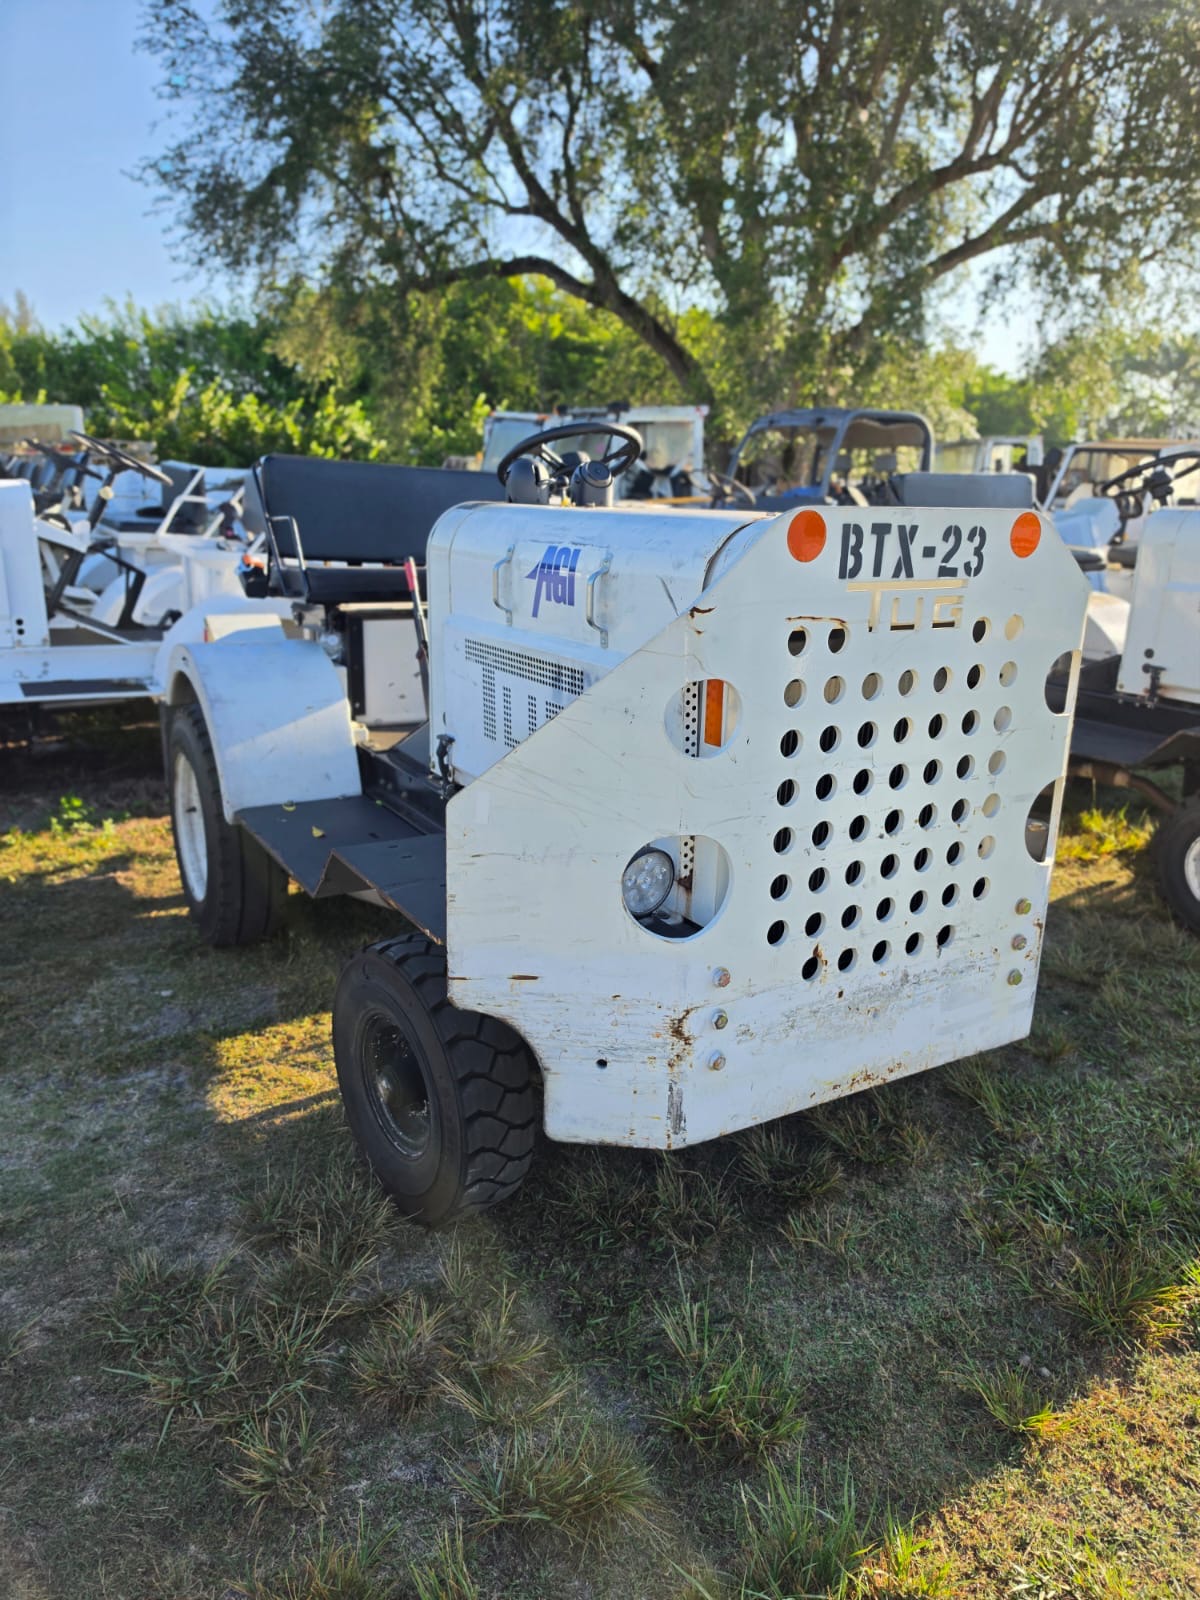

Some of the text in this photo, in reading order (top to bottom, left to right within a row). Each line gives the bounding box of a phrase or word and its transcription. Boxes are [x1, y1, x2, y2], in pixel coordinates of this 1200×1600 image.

[525, 545, 581, 618] AGI
[838, 523, 987, 579] BTX-23
[847, 579, 968, 632] TUG
[465, 638, 584, 749] TU
